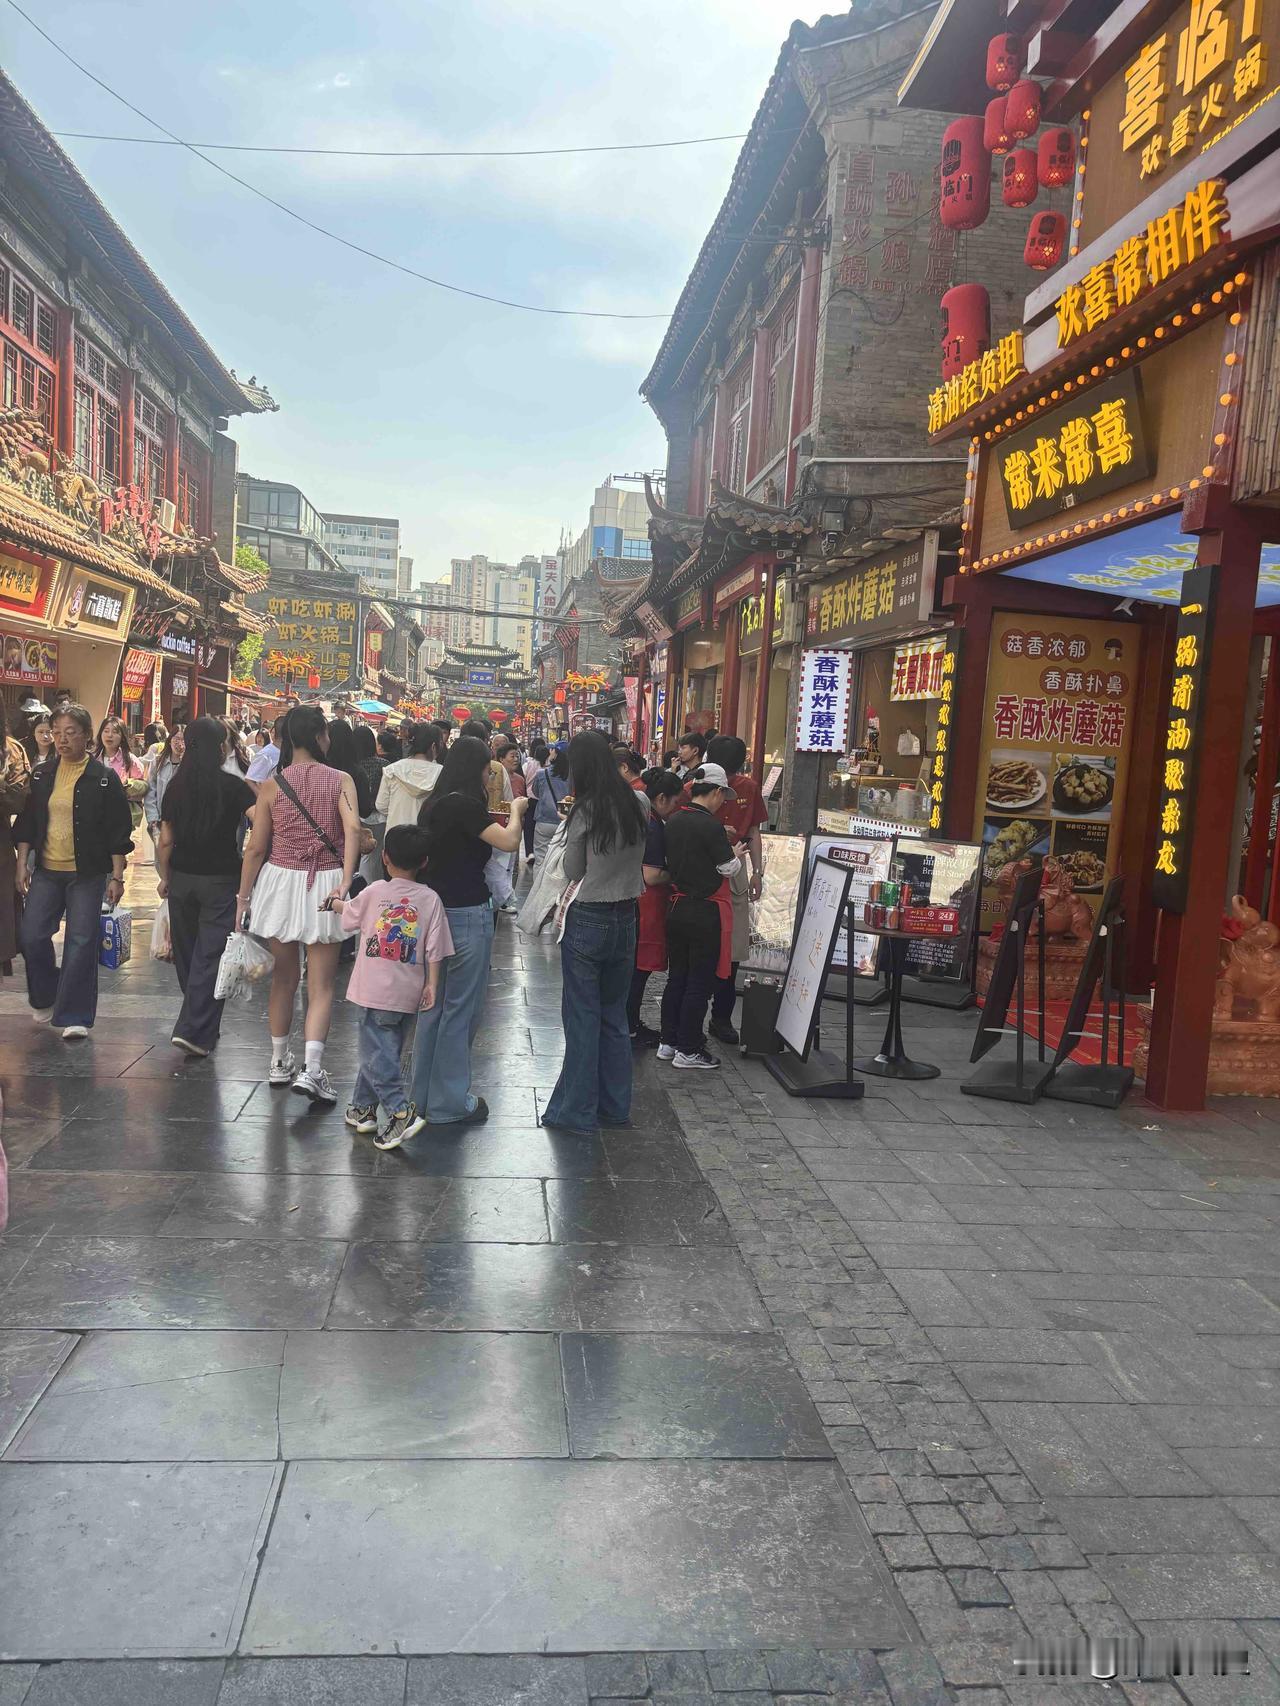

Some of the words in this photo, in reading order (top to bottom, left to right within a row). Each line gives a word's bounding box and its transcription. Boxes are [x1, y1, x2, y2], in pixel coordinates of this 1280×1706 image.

[1139, 42, 1263, 180] 欢喜火锅
[1054, 178, 1230, 348] 欢喜常相伴
[926, 329, 1026, 435] 清油轻负担
[1003, 398, 1135, 511] 常来常喜
[268, 597, 356, 621] 虾吃虾涮
[820, 560, 898, 633] 香酥炸蘑菇
[177, 635, 191, 655] coffee
[1006, 634, 1086, 659] 菇香浓郁
[808, 656, 840, 747] 香酥炸蘑菇
[1044, 670, 1123, 696] 香酥扑鼻
[993, 694, 1127, 748] 香酥炸蘑菇
[832, 849, 866, 863] 口味反馈
[922, 867, 945, 877] Brand
